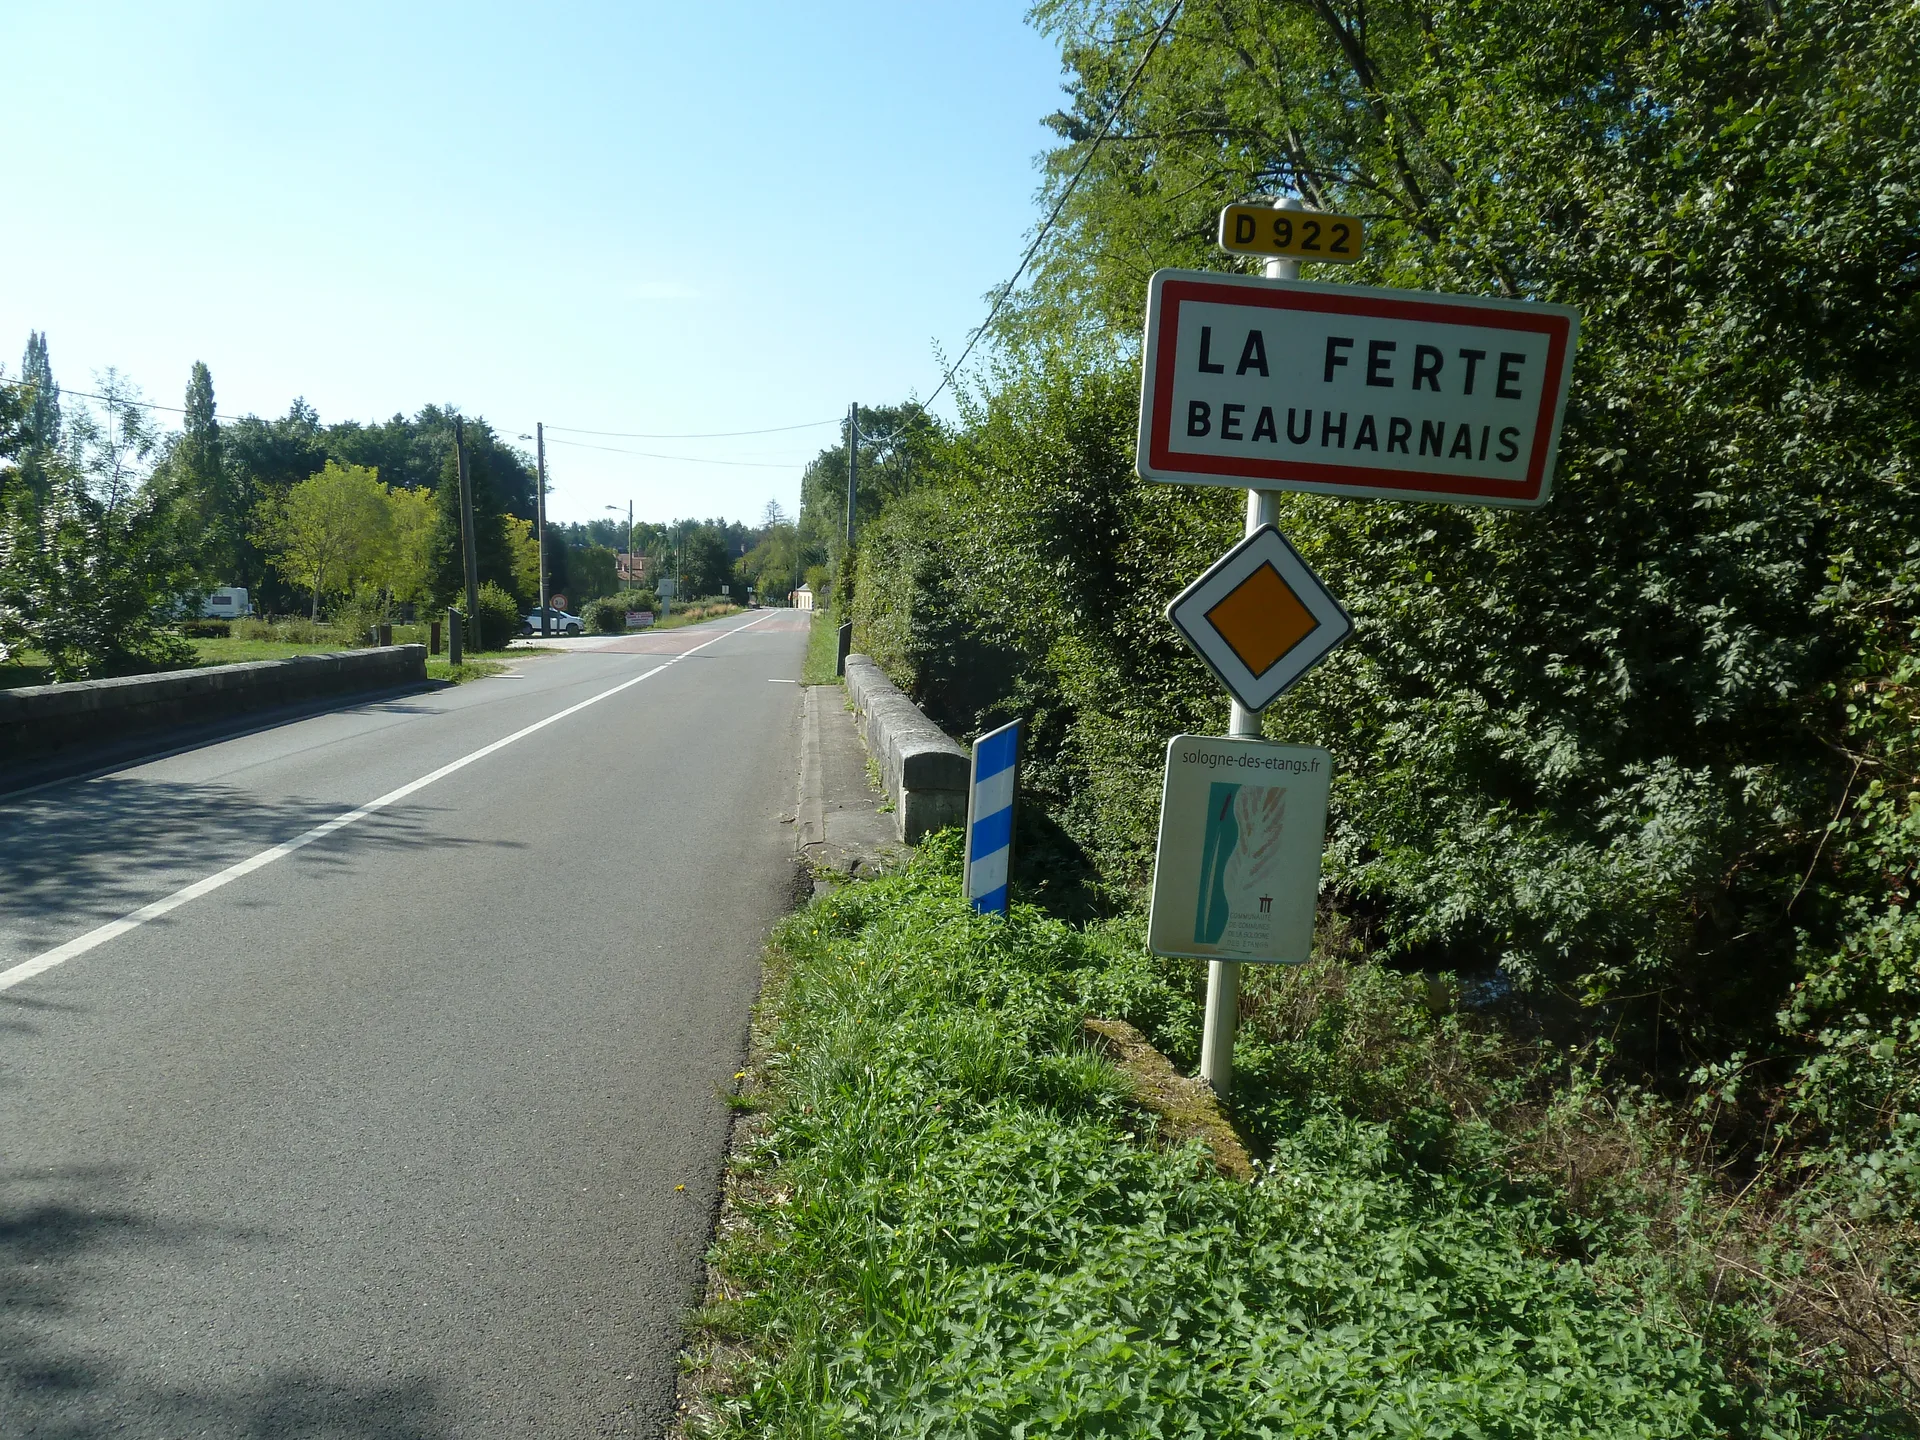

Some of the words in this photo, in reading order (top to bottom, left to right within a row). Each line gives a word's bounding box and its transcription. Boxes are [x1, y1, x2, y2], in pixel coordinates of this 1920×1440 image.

[1234, 214, 1257, 245] D
[1272, 217, 1351, 254] 922
[1197, 325, 1270, 378] LA
[1323, 335, 1527, 400] FERTE
[1186, 400, 1521, 463] BEAUHARNAIS
[1182, 749, 1320, 775] sologne-des-etangs.fr
